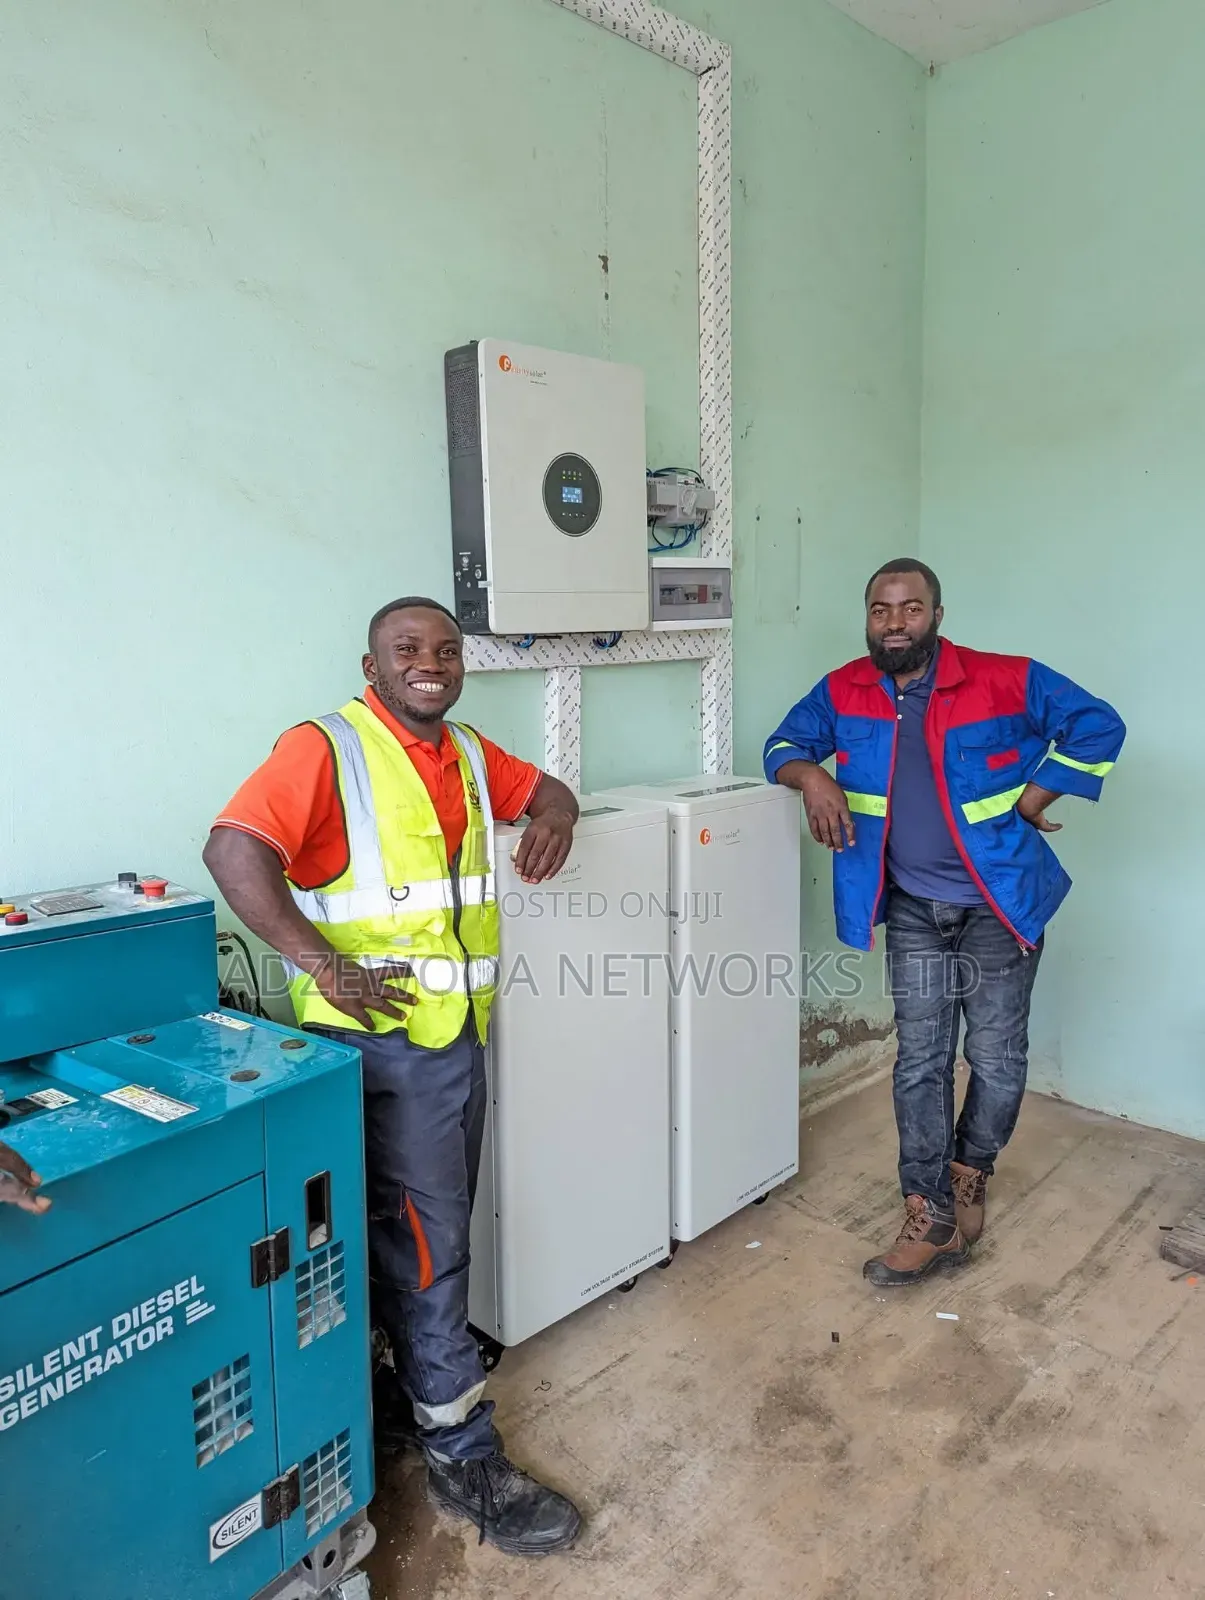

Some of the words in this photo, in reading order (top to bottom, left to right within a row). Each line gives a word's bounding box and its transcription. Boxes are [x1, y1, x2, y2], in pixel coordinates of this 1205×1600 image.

[580, 1287, 591, 1297] LOW
[592, 1276, 611, 1290] VOLTAGE
[611, 1266, 628, 1279] ENERGY
[628, 1253, 648, 1269] STORAGE
[648, 1245, 664, 1258] SYSTEM
[0, 1326, 103, 1402] SILENT
[112, 1275, 205, 1340] DIESEL
[0, 1315, 174, 1431] GENERATOR
[221, 1508, 258, 1541] SILENT
